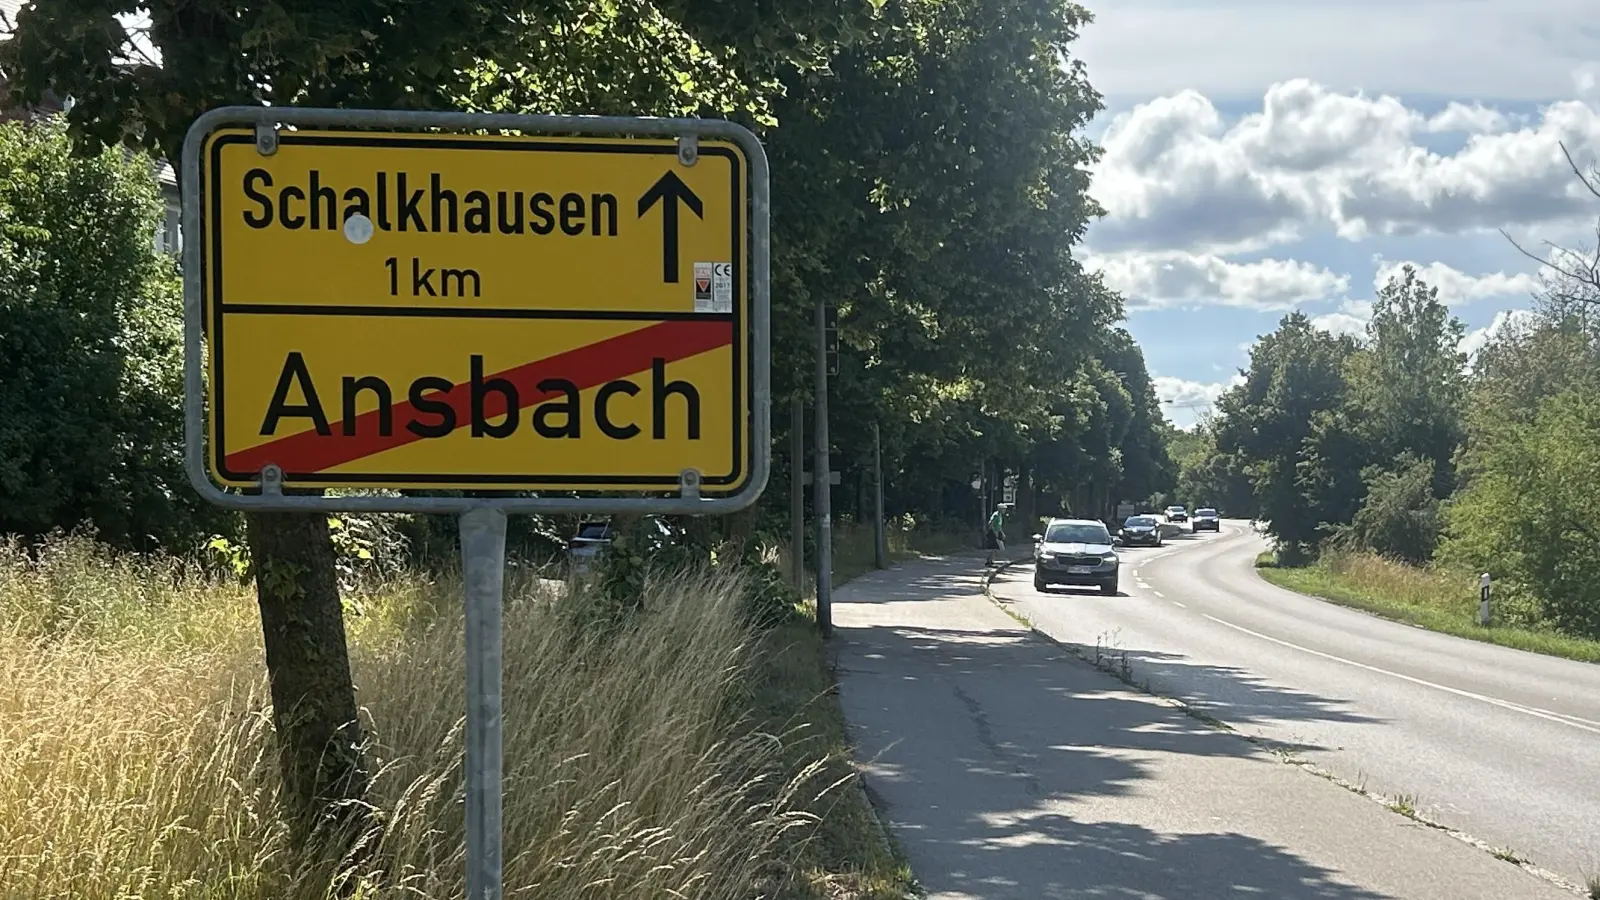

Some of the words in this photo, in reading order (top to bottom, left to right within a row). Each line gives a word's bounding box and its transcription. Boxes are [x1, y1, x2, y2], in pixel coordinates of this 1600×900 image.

[243, 168, 618, 237] Schalkhausen
[385, 257, 398, 296] 1
[412, 257, 481, 298] km
[714, 264, 731, 277] CE
[259, 351, 701, 441] Ansbach
